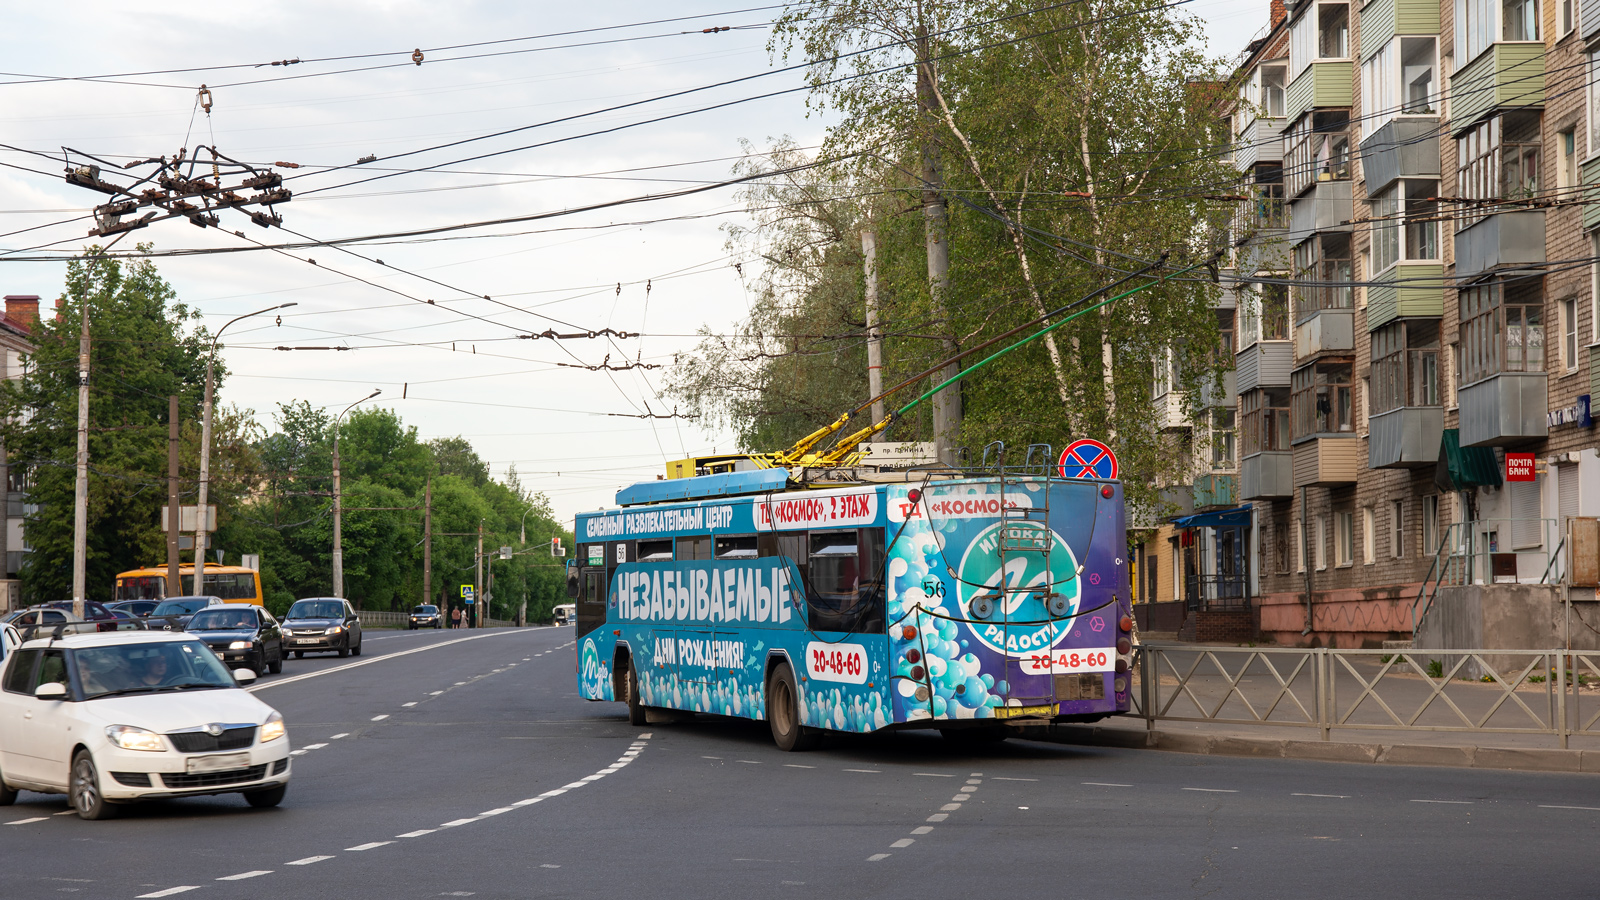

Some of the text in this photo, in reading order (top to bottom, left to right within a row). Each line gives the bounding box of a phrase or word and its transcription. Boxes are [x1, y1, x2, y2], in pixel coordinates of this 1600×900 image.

[1508, 458, 1532, 466] ПОЧТА
[1508, 468, 1530, 476] БАНК
[760, 494, 870, 527] ТЦ «КОСМОС», 2 ЭТАЖ
[899, 499, 1018, 518] ТЦ «КОСМОС»
[586, 503, 732, 538] СЕМЕЙНЫЙ РАЗВЛЕКАТЕЛЬНЫЙ ЦЕНТР
[618, 548, 625, 560] 56
[1115, 558, 1123, 566] 0+
[618, 567, 792, 624] НЕЗАБЫВАЕМЫЕ
[924, 580, 946, 598] 56
[984, 622, 1059, 651] РАДОСТИ
[654, 638, 744, 671] ДНИ РОЖДЕНИЯ!
[814, 649, 860, 676] 20-48-60
[1032, 652, 1106, 669] 20-48-60
[872, 660, 881, 673] 0+
